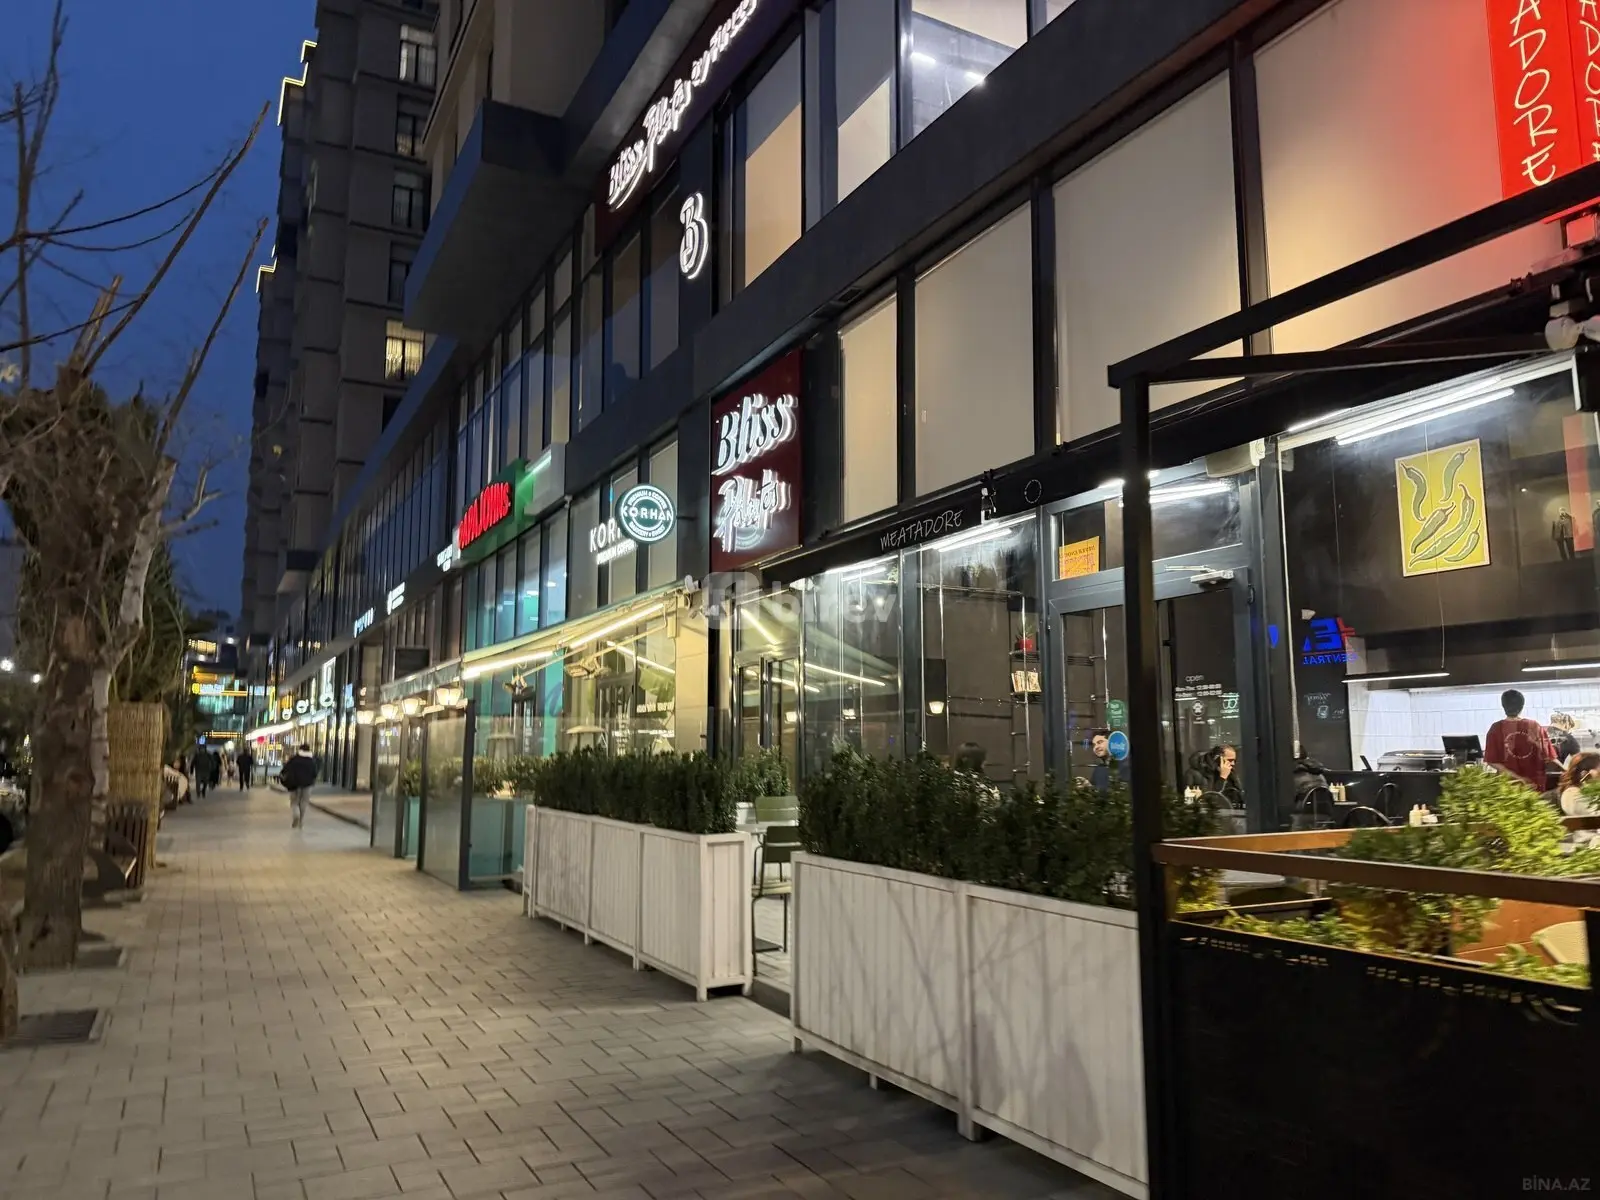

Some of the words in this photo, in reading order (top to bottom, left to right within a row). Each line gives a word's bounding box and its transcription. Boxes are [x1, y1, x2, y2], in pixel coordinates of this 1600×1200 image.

[711, 393, 798, 475] Bliss
[622, 505, 674, 522] KORHAN
[880, 510, 963, 551] MEATADORE
[590, 518, 621, 553] KOR
